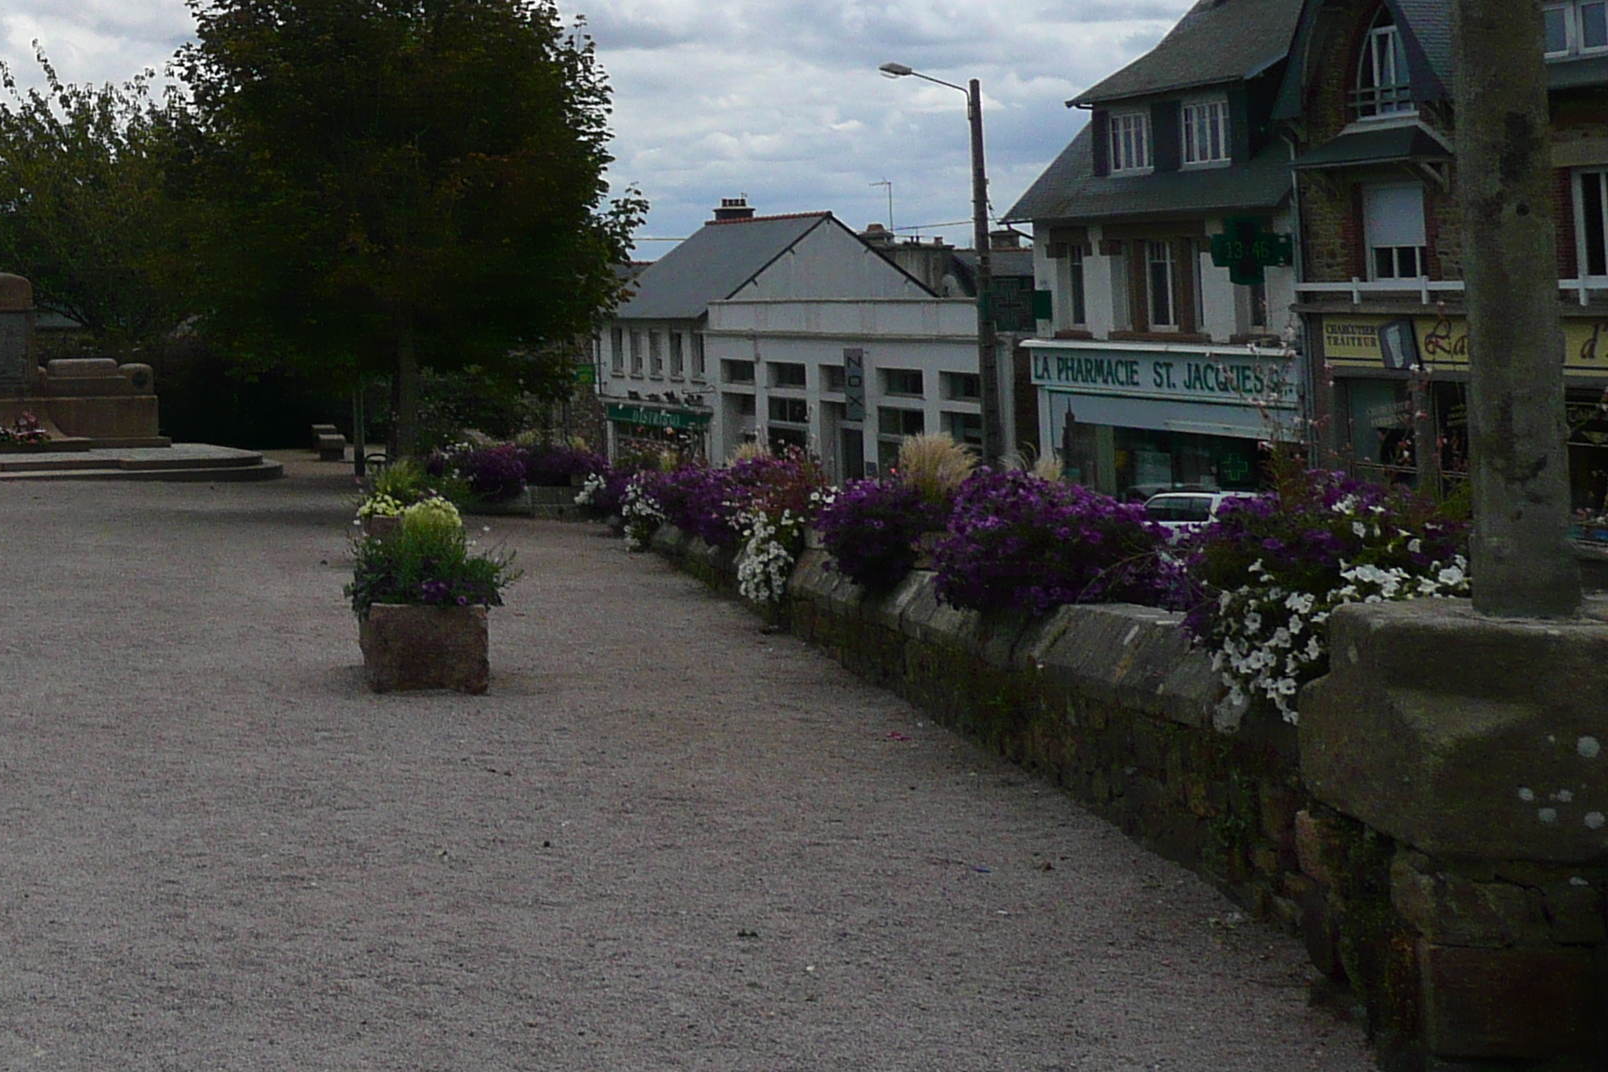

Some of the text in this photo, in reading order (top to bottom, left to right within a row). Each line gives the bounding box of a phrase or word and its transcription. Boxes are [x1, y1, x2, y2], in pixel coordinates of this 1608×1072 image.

[1326, 335, 1378, 348] TRAITEUR
[1033, 355, 1051, 380] LA
[1057, 356, 1140, 387] PHARMACIE
[1152, 360, 1176, 389] ST.
[1183, 362, 1263, 394] JACQUES
